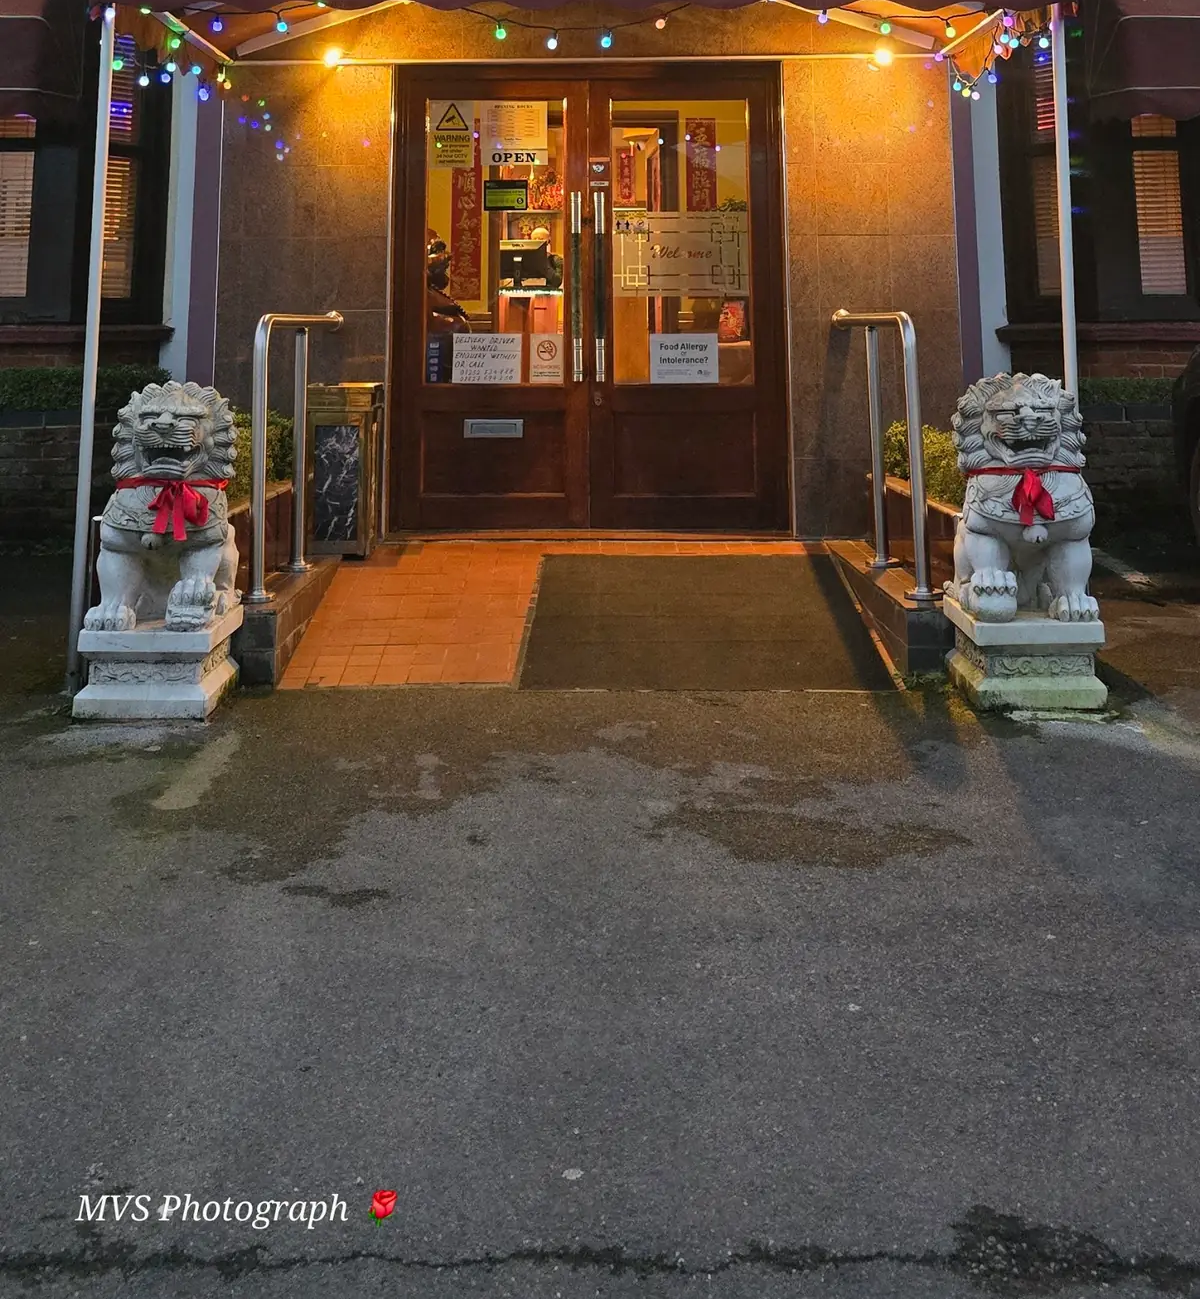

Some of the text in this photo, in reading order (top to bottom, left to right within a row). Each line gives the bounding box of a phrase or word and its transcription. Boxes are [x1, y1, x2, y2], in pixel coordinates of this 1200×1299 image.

[434, 134, 471, 142] WARNING
[491, 152, 537, 163] OPEN
[455, 336, 486, 344] DELIVERY
[471, 344, 498, 352] WANTED
[660, 342, 708, 352] Food Allergy
[455, 360, 465, 368] OR
[660, 356, 709, 364] Intolerance?
